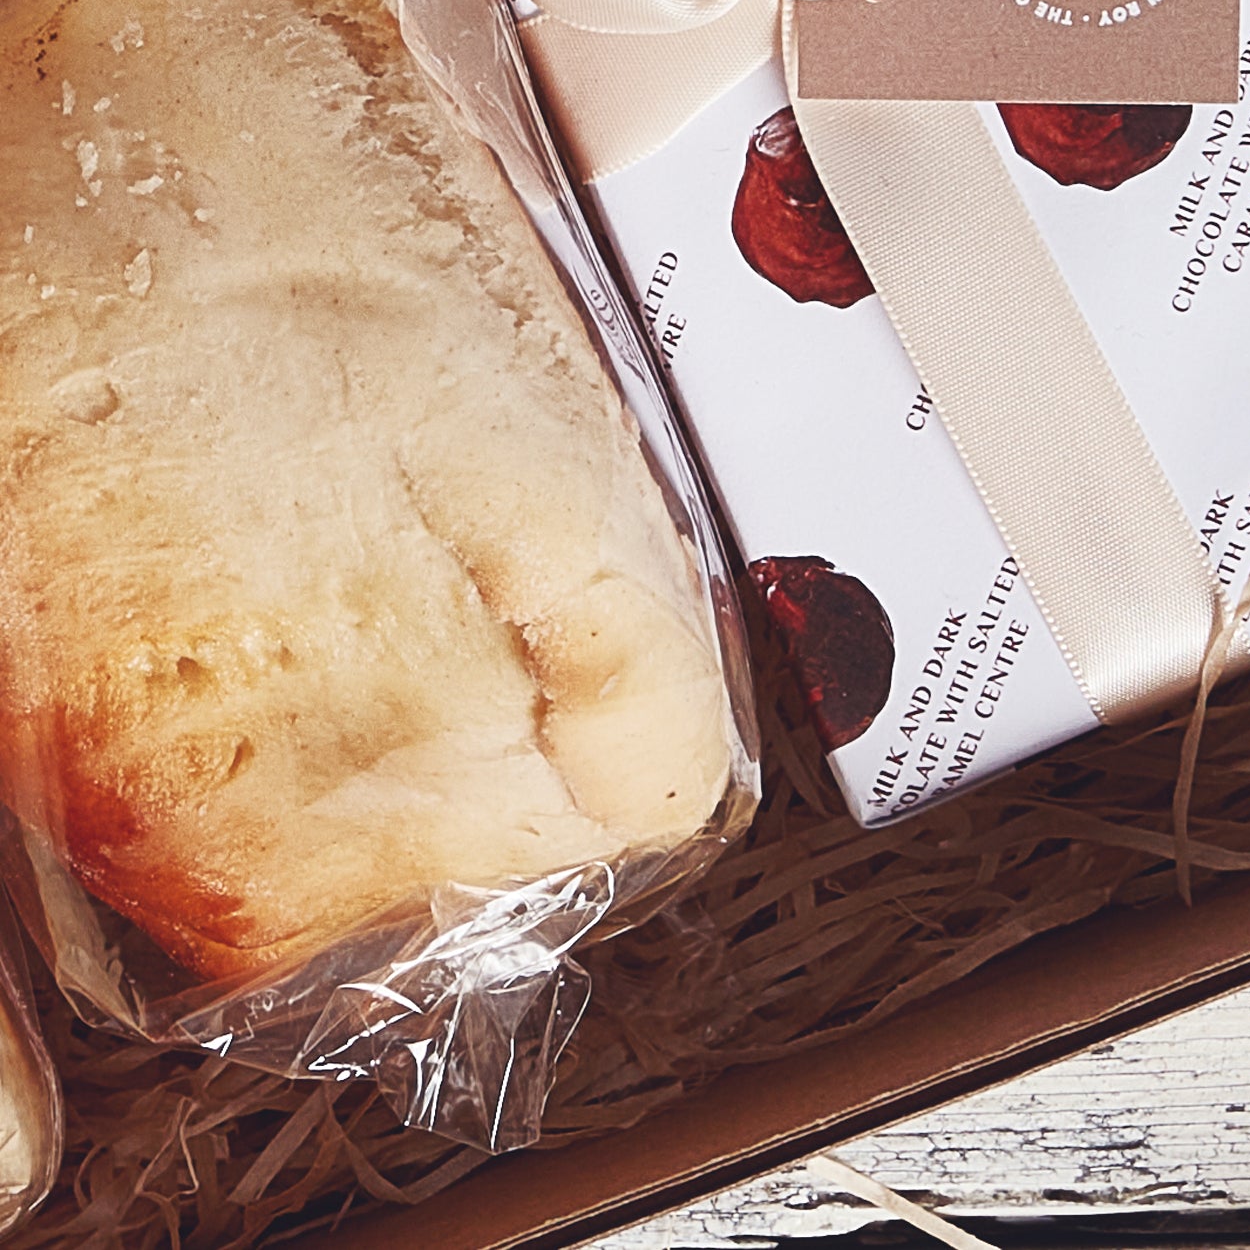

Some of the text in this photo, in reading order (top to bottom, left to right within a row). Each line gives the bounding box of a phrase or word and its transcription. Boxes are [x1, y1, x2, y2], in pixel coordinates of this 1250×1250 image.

[1034, 1, 1073, 26] THE
[1099, 1, 1140, 26] ROY
[1169, 171, 1210, 236] MILK
[1202, 109, 1234, 166] AND
[1172, 156, 1249, 313] CHOCOLATE
[1217, 542, 1246, 584] ITH
[936, 660, 978, 723] WITH
[969, 557, 1020, 653] SALTED
[975, 620, 1029, 718] CENTRE
[868, 609, 967, 807] MILK AND DARK
